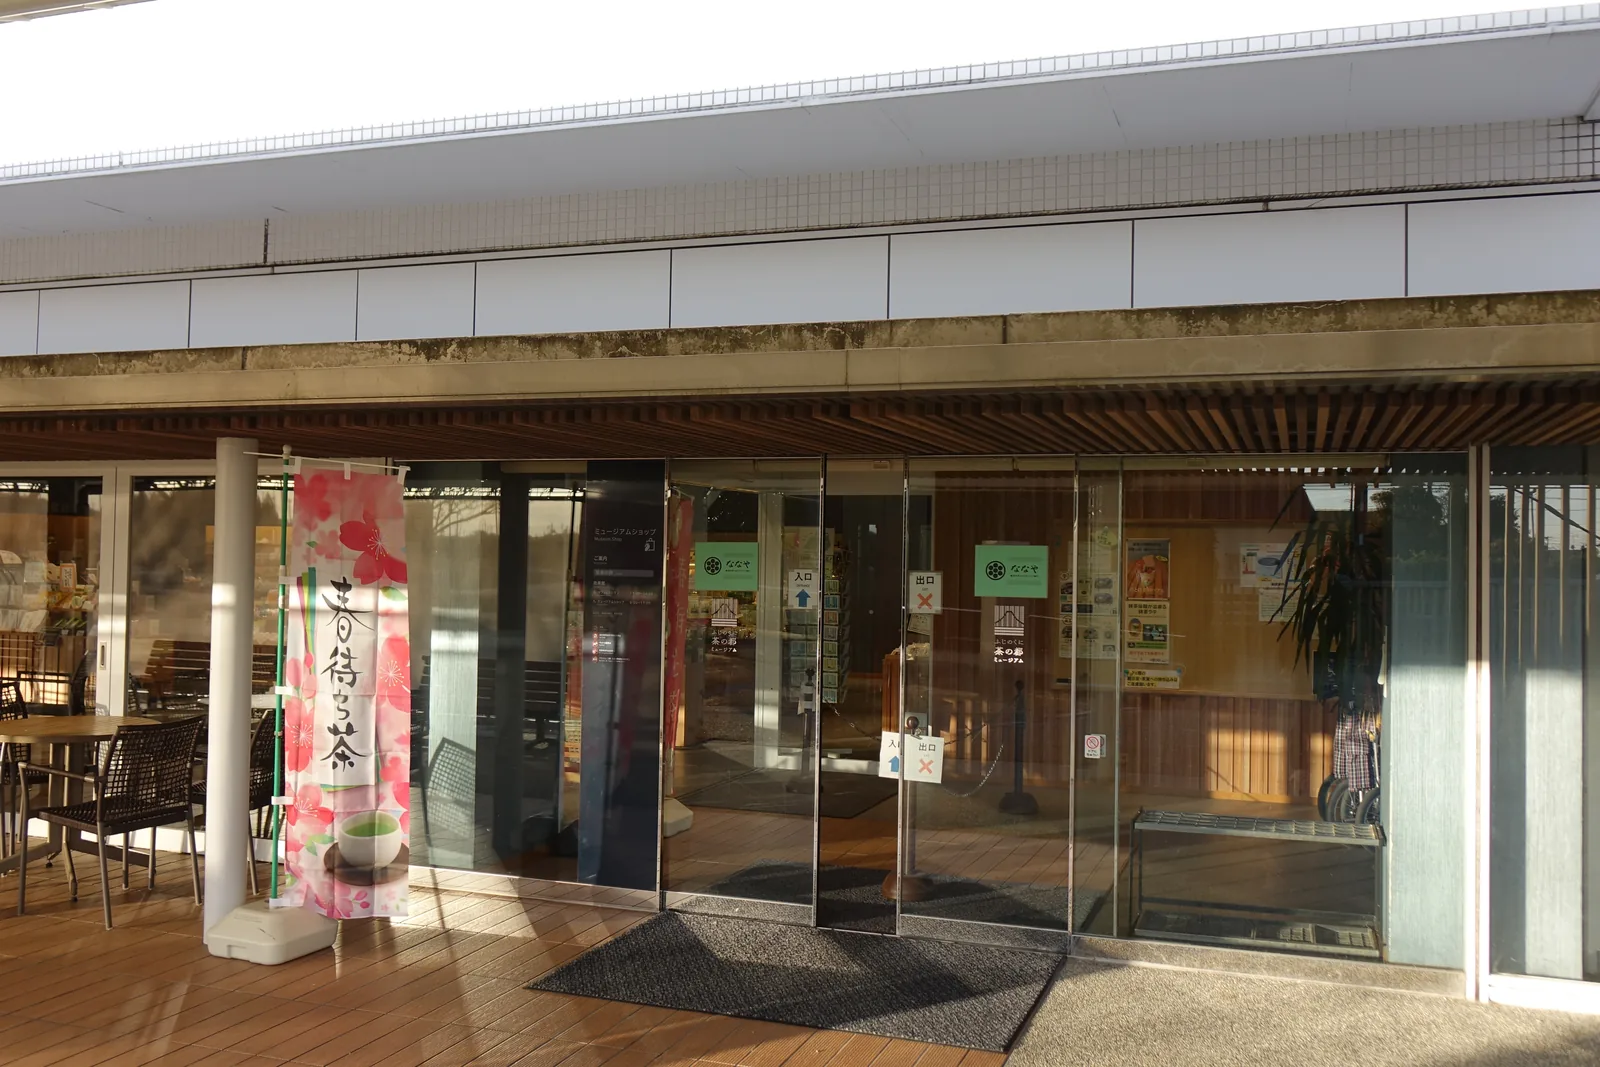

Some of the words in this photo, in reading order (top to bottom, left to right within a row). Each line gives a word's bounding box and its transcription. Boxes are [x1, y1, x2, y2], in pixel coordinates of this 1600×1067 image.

[595, 528, 657, 536] ミュージアムショップ
[725, 560, 751, 569] ななや
[1010, 564, 1039, 574] ななや
[794, 572, 812, 582] 入口
[916, 575, 935, 585] 出口
[711, 637, 737, 646] 茶の都
[994, 646, 1024, 657] 茶の都
[993, 656, 1024, 664] ミュージアム
[319, 576, 374, 773] 春待ち茶
[888, 739, 900, 749] 入
[918, 742, 936, 752] 出口
